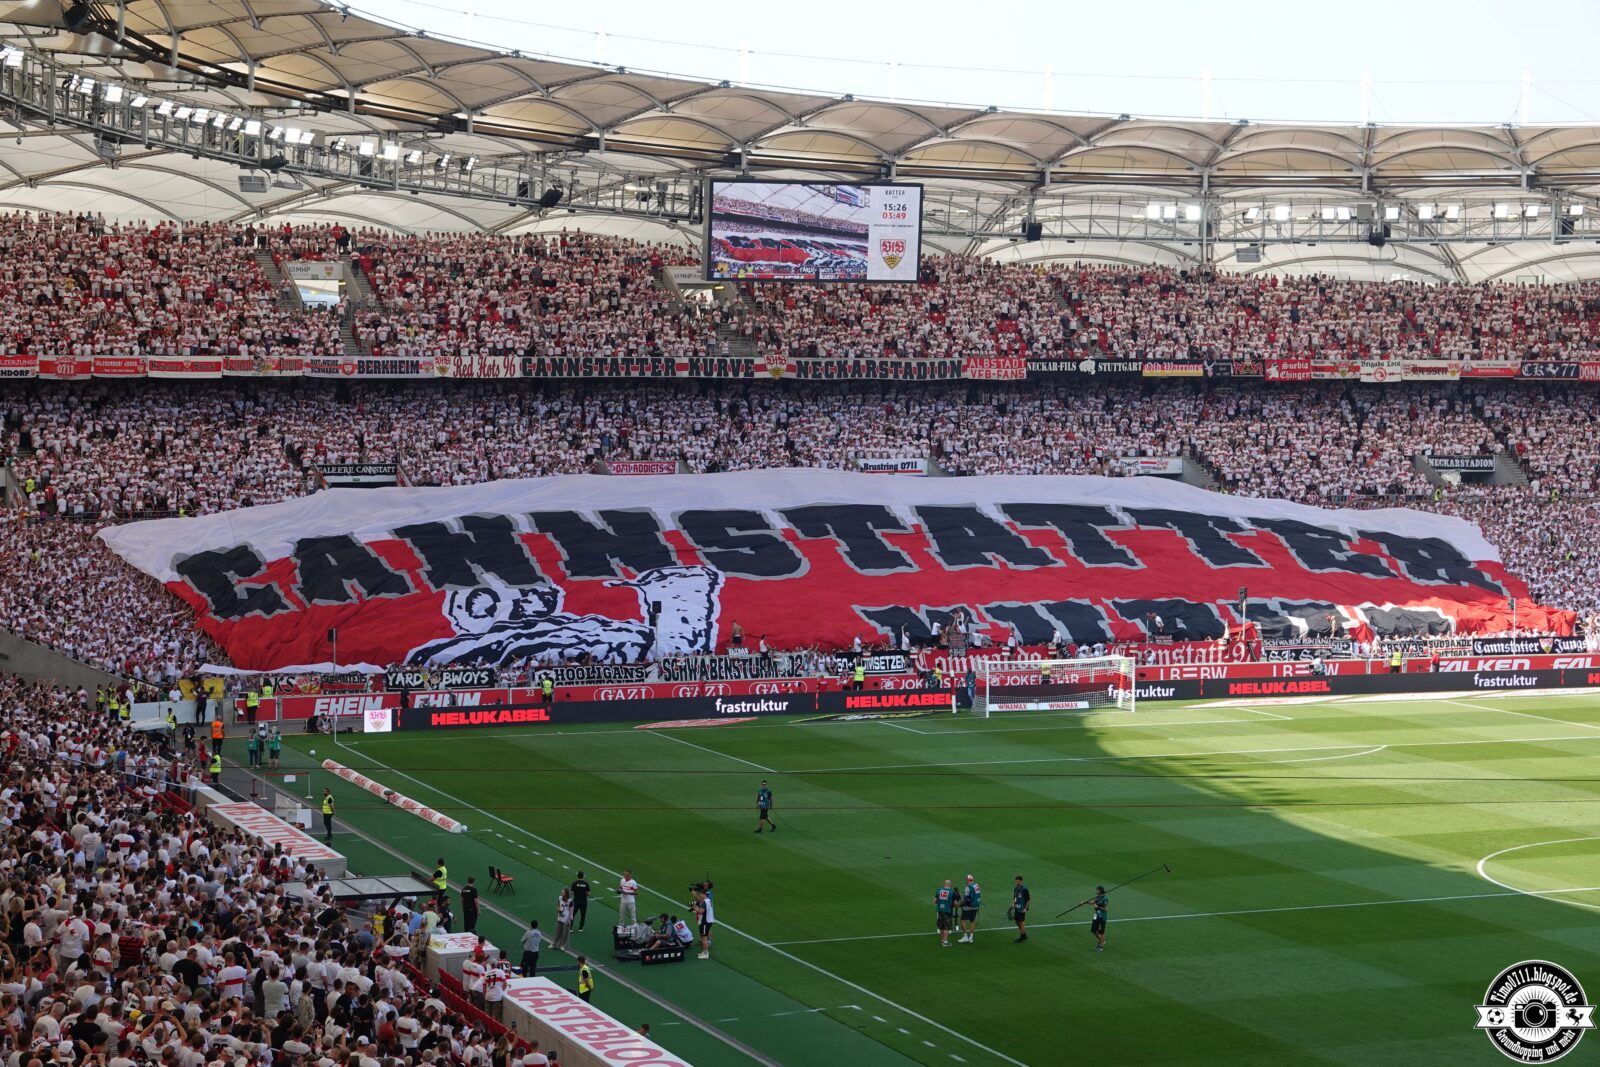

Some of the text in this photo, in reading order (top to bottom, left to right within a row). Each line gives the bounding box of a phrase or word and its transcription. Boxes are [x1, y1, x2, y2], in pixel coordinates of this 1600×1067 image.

[883, 203, 907, 211] 15:26
[882, 212, 906, 220] 03:49
[57, 363, 75, 375] 0711
[358, 359, 419, 374] BERKHEIM
[453, 355, 516, 378] Red Hots 96
[522, 357, 755, 377] CANNSTATTER KURVE
[968, 357, 1026, 369] ALBSTADT
[1027, 360, 1077, 372] NECKAR-FILS
[1097, 361, 1143, 372] STUTTGART
[1144, 360, 1162, 373] Old
[1163, 361, 1204, 373] Warriors
[1281, 361, 1309, 370] Suebia
[1361, 360, 1385, 368] Brigada
[1521, 361, 1578, 377] CK 77
[796, 360, 963, 379] NECKARSTADION
[970, 368, 1025, 379] VFB-FANS
[1280, 370, 1311, 380] Ehingen
[633, 463, 664, 473] ADDICTS
[863, 461, 917, 471] Brustring 0711
[1428, 458, 1494, 468] NECKARSTADION
[317, 464, 396, 475] GALEERE CANNSTATT
[172, 503, 1507, 619] CANNSTATTER
[1413, 642, 1424, 653] 36
[1474, 638, 1587, 655] Cannstatter Jungs
[1437, 658, 1531, 674] FALKEN
[388, 670, 490, 687] YARD BWOYS
[554, 665, 645, 681] HOOLIGANS
[1474, 673, 1538, 688] frastruktur
[525, 689, 535, 697] 33
[600, 687, 647, 700] GAZI
[1229, 681, 1331, 694] HELUKABEL
[313, 695, 384, 716] EHEIM
[715, 698, 789, 713] frastruktur
[846, 692, 953, 709] HELUKABEL
[997, 702, 1028, 710] WINAMAX
[1048, 701, 1079, 709] WINAMAX
[431, 708, 550, 726] HELUKABEL
